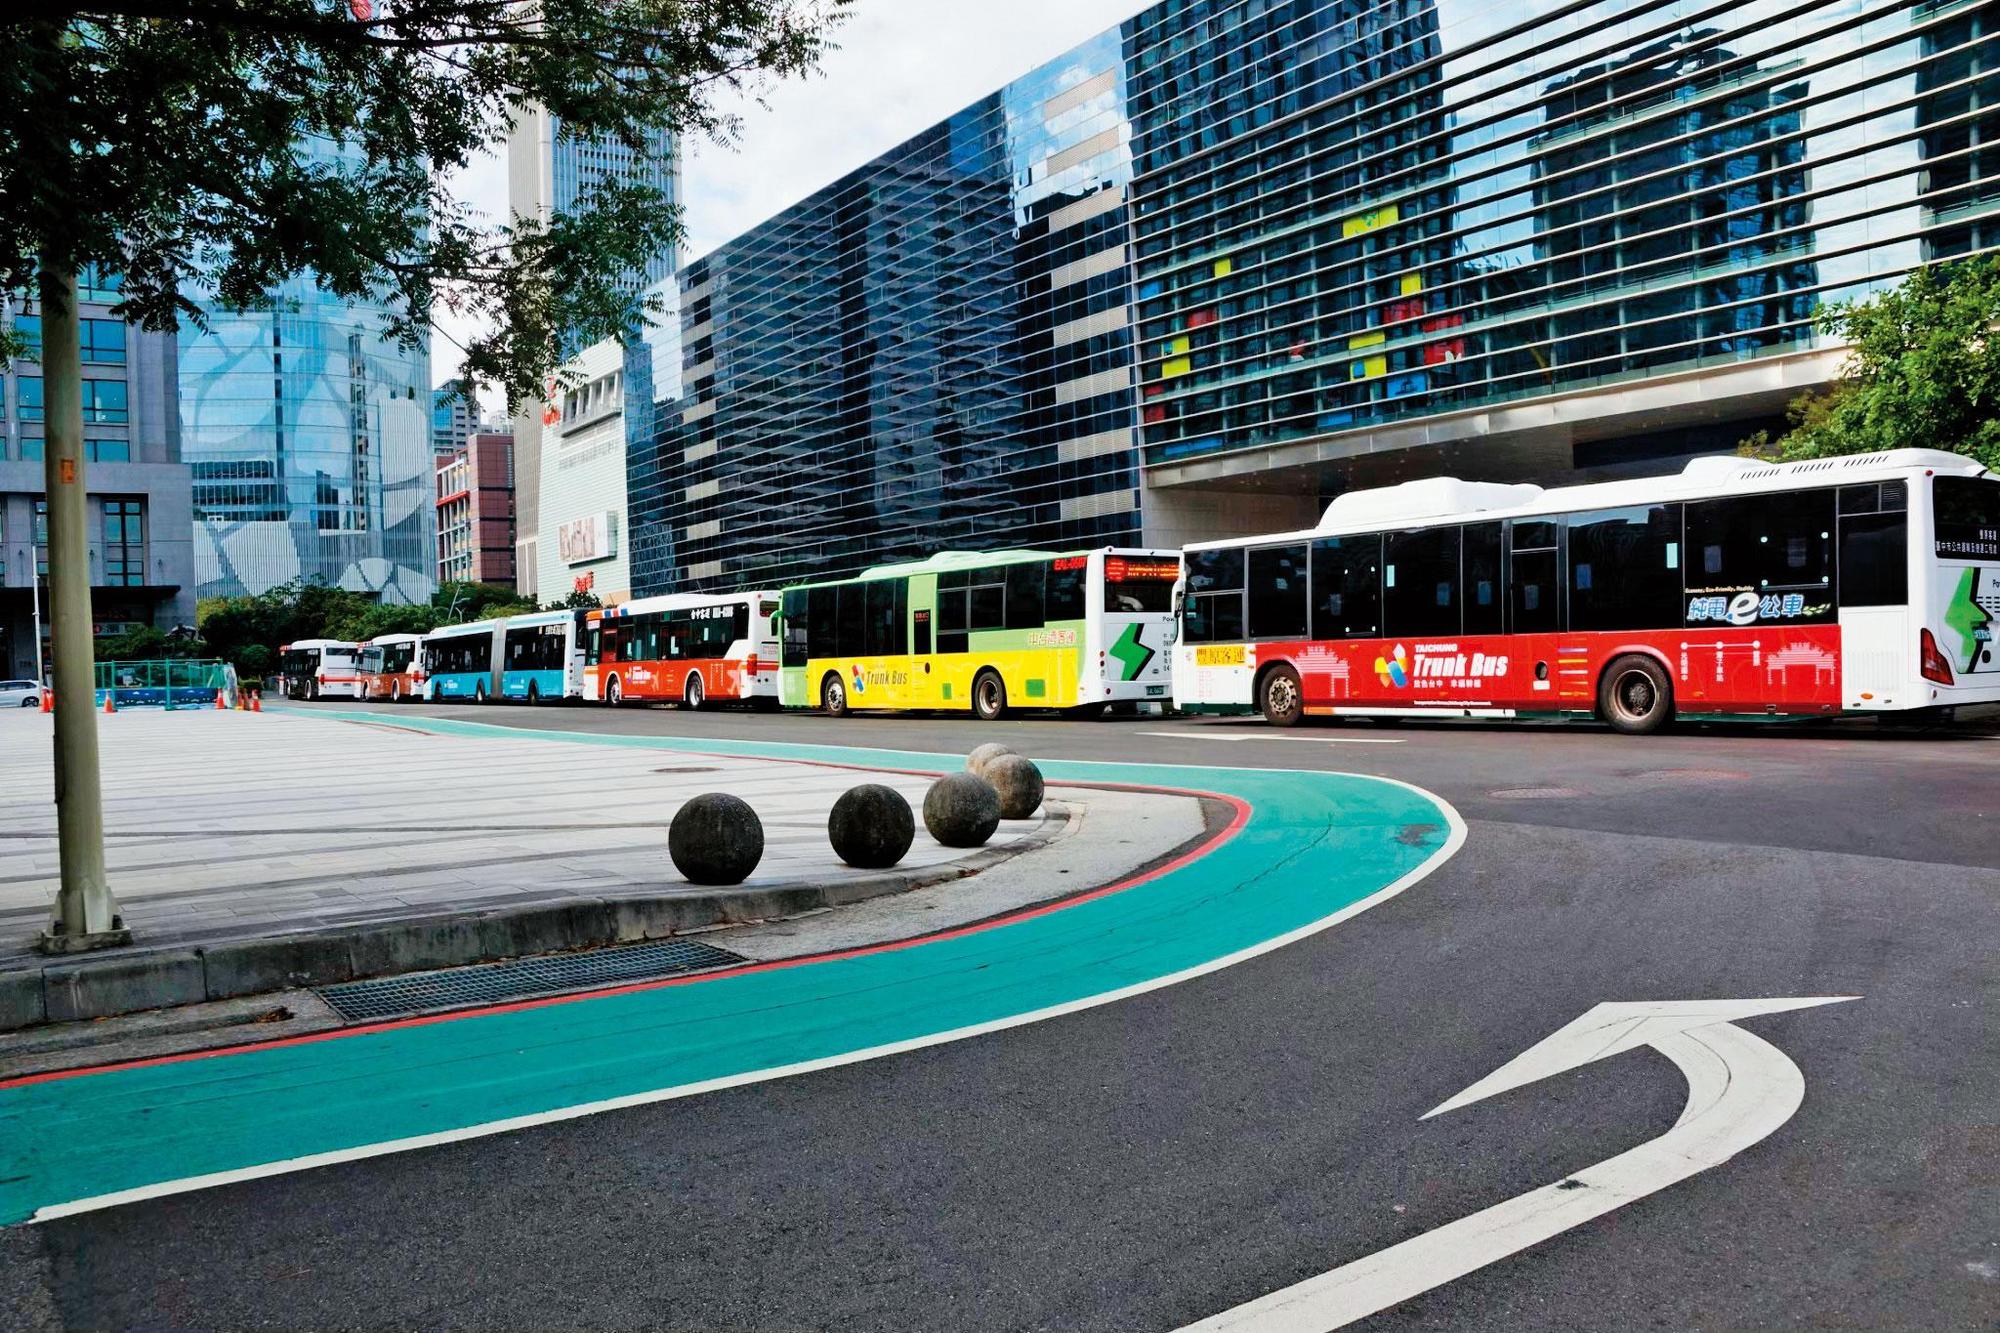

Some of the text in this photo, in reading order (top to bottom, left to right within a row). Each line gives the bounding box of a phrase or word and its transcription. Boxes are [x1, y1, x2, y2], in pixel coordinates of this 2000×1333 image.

[1413, 652, 1509, 677] Trunk Bus
[866, 670, 908, 685] Trunk Bus
